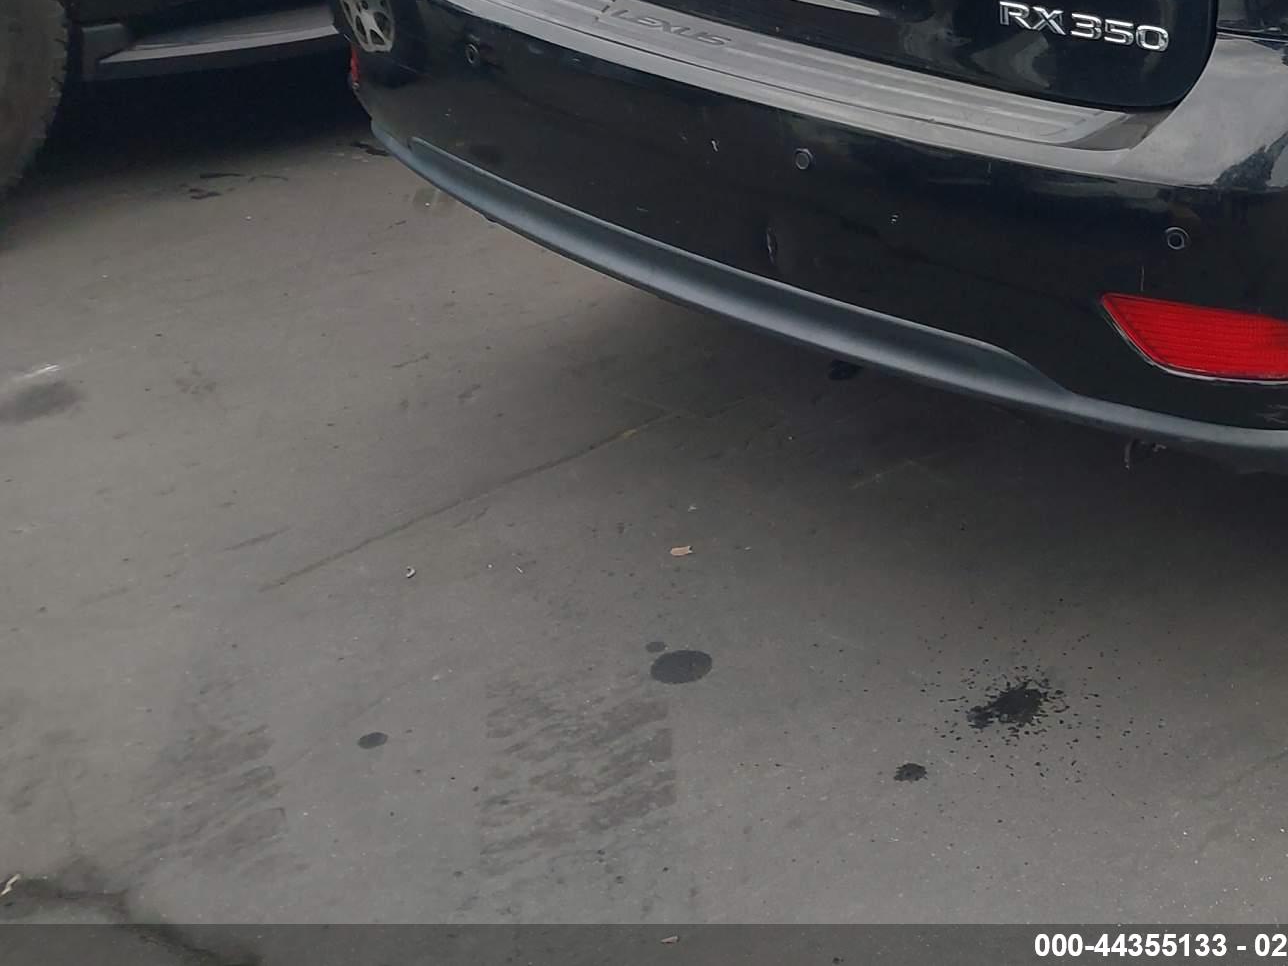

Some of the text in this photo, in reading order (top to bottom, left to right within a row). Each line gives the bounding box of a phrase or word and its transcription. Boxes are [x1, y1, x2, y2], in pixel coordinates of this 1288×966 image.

[610, 9, 732, 46] LEXUS
[999, 0, 1170, 52] RX 350
